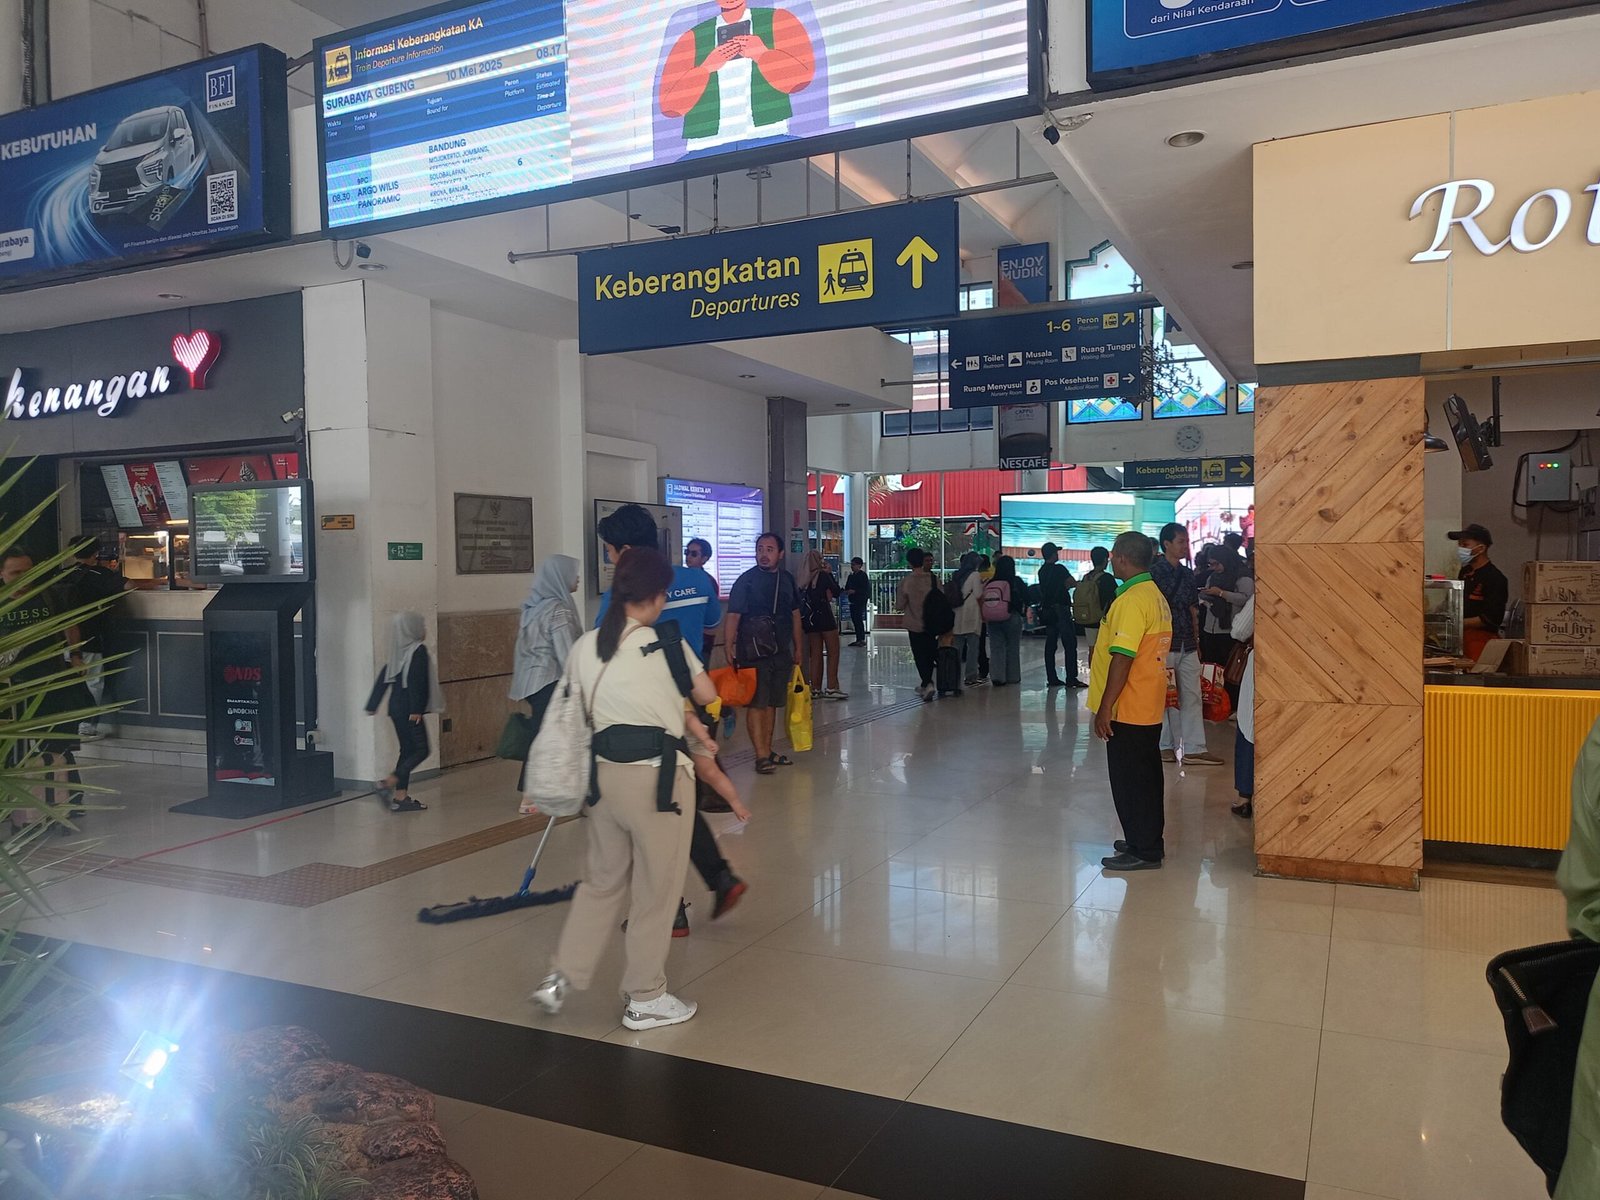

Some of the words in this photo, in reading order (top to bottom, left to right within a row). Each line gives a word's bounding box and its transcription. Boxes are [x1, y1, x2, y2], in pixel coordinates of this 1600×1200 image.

[1150, 13, 1170, 24] dari
[1173, 8, 1195, 20] Nilai
[1197, 0, 1254, 14] Kendaraan
[355, 41, 396, 61] Informasi
[397, 23, 467, 51] Keberangkatan
[468, 17, 484, 31] KA
[355, 62, 371, 73] Train
[372, 54, 405, 70] Departure
[406, 45, 444, 62] Information
[209, 73, 232, 98] BFI
[326, 92, 373, 110] SURABAYA
[375, 80, 415, 98] GUBENG
[446, 70, 456, 81] 10
[458, 66, 477, 79] Mei
[479, 60, 503, 74] 2025
[208, 100, 234, 110] FINANCE
[1, 122, 97, 161] KEBUTUHAN
[428, 138, 466, 154] BANDUNG
[518, 158, 523, 166] 6
[357, 185, 377, 197] ARGO
[378, 180, 399, 192] WILIS
[332, 192, 351, 203] 08.30
[357, 193, 401, 209] PANORAMIC
[1001, 255, 1045, 271] ENJOY
[595, 256, 800, 300] Keberangkatan
[1002, 266, 1044, 280] MUDIK
[691, 291, 800, 319] Departures
[1077, 316, 1099, 325] Peron
[983, 354, 1004, 363] Toilet
[1025, 350, 1052, 358] Musala
[1080, 345, 1105, 354] Ruang
[1106, 343, 1136, 351] Tunggu
[4, 366, 170, 418] kenangan
[963, 385, 986, 393] Ruang
[987, 380, 1022, 390] Menyusui
[1059, 376, 1099, 385] Kesehatan
[1136, 465, 1198, 475] Keberangkatan
[674, 587, 697, 597] CARE
